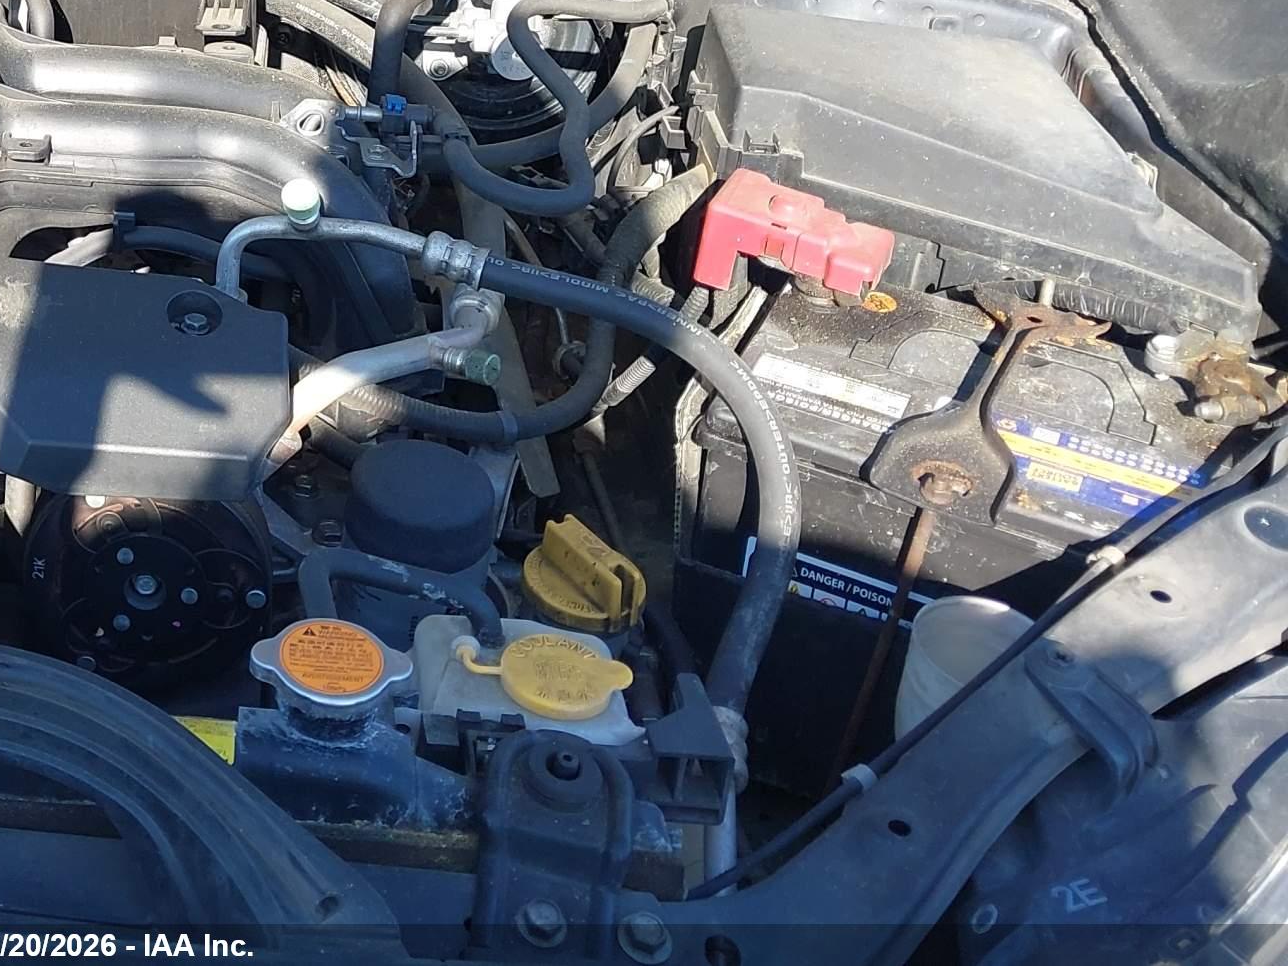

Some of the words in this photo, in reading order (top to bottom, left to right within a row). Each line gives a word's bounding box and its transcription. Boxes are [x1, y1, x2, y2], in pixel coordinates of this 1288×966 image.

[800, 566, 845, 591] DANGER
[846, 585, 852, 594] /
[852, 586, 893, 607] POISON
[510, 635, 600, 659] COOLANT
[1051, 878, 1108, 914] 2E
